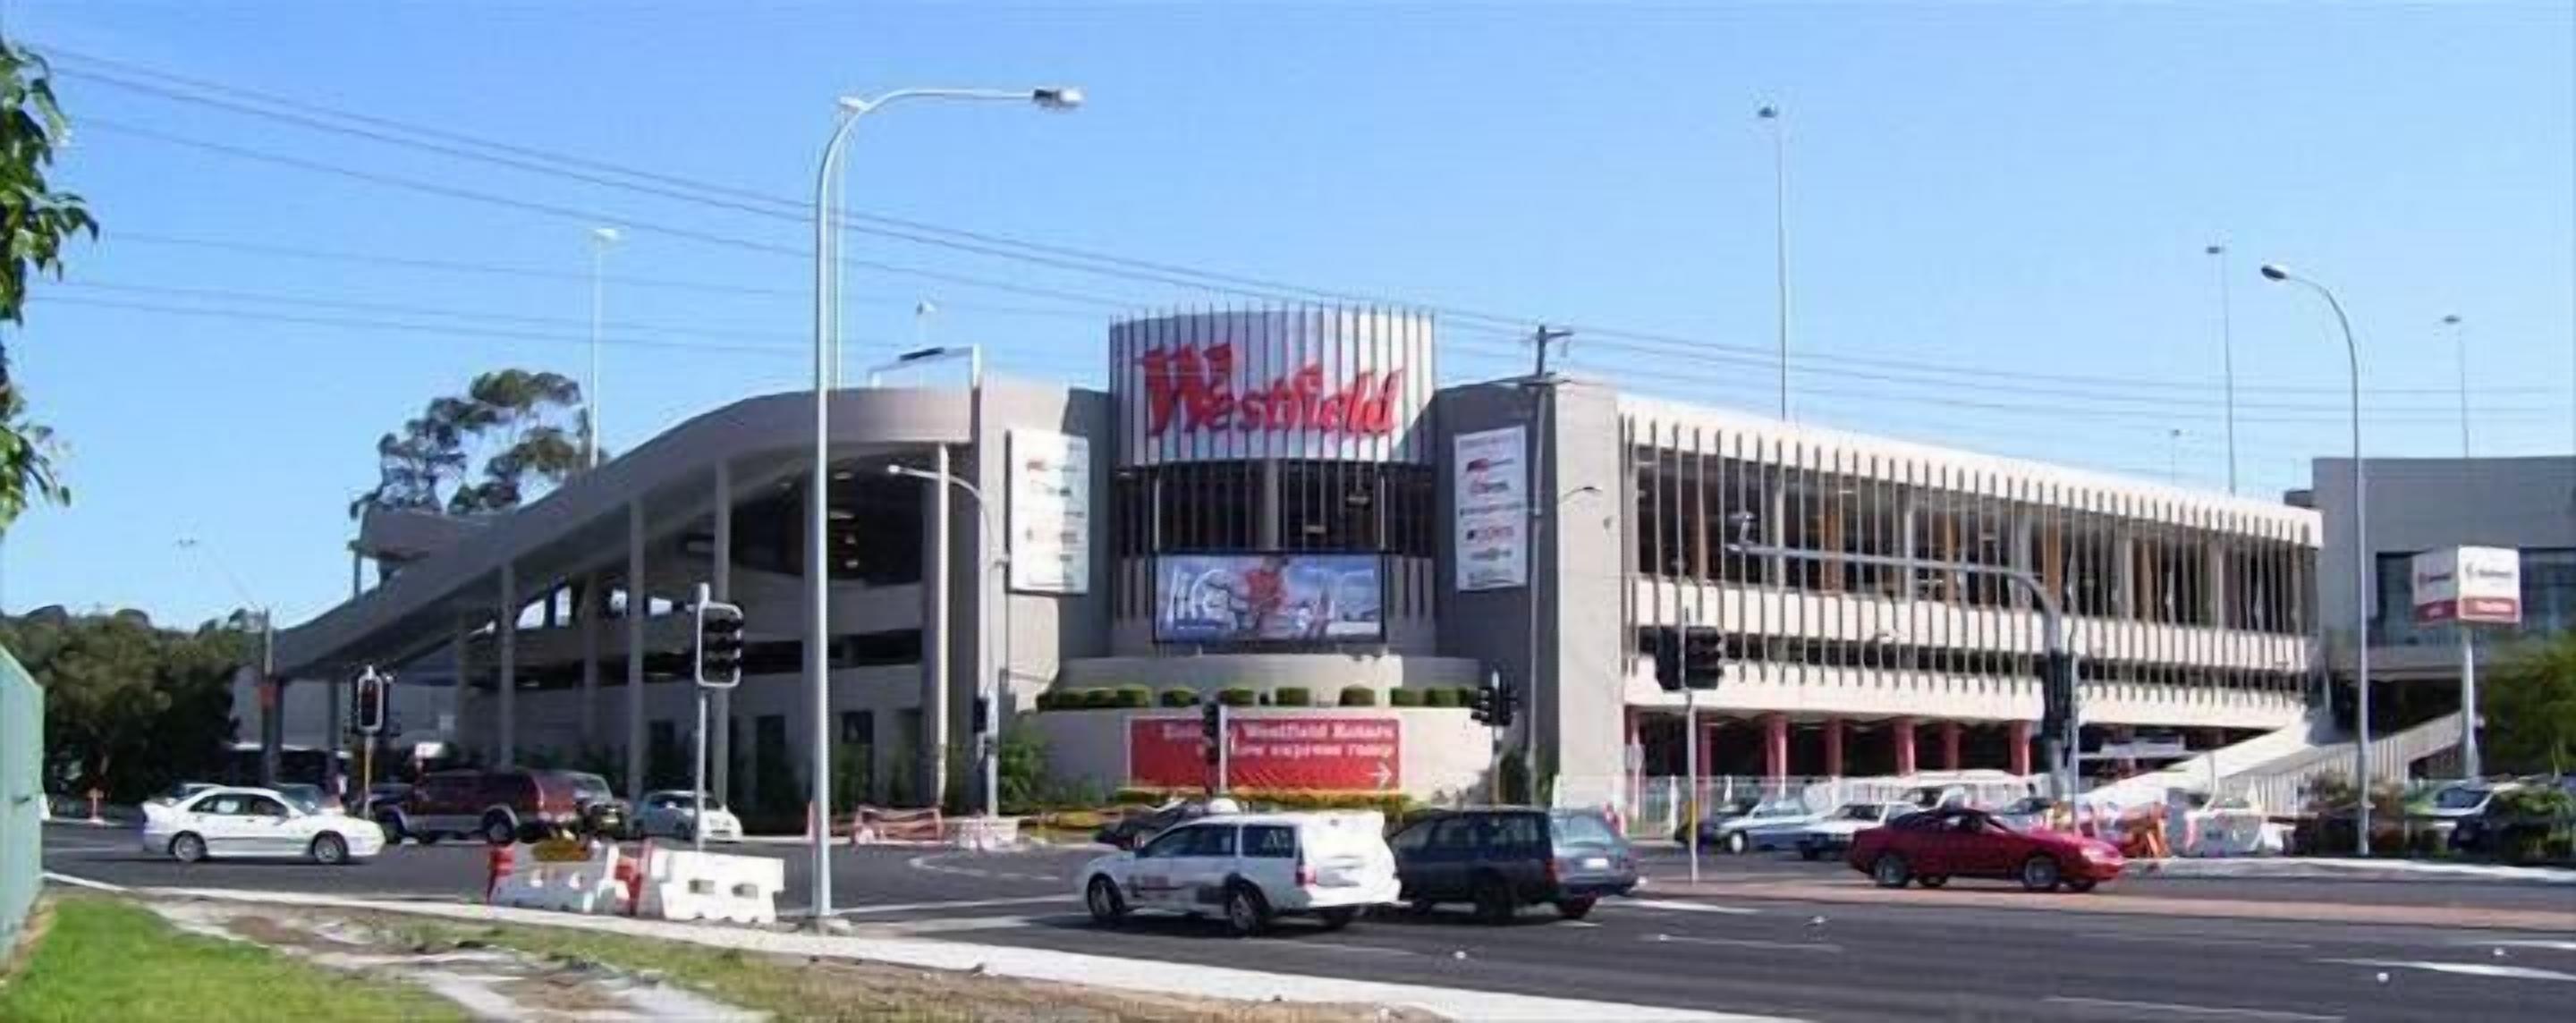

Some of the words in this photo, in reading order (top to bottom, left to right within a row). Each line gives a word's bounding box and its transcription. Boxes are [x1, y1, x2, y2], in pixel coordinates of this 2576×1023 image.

[1136, 343, 1402, 436] Westfield
[1241, 723, 1327, 739] Westfield
[1270, 744, 1341, 759] express
[1348, 743, 1393, 758] ramp
